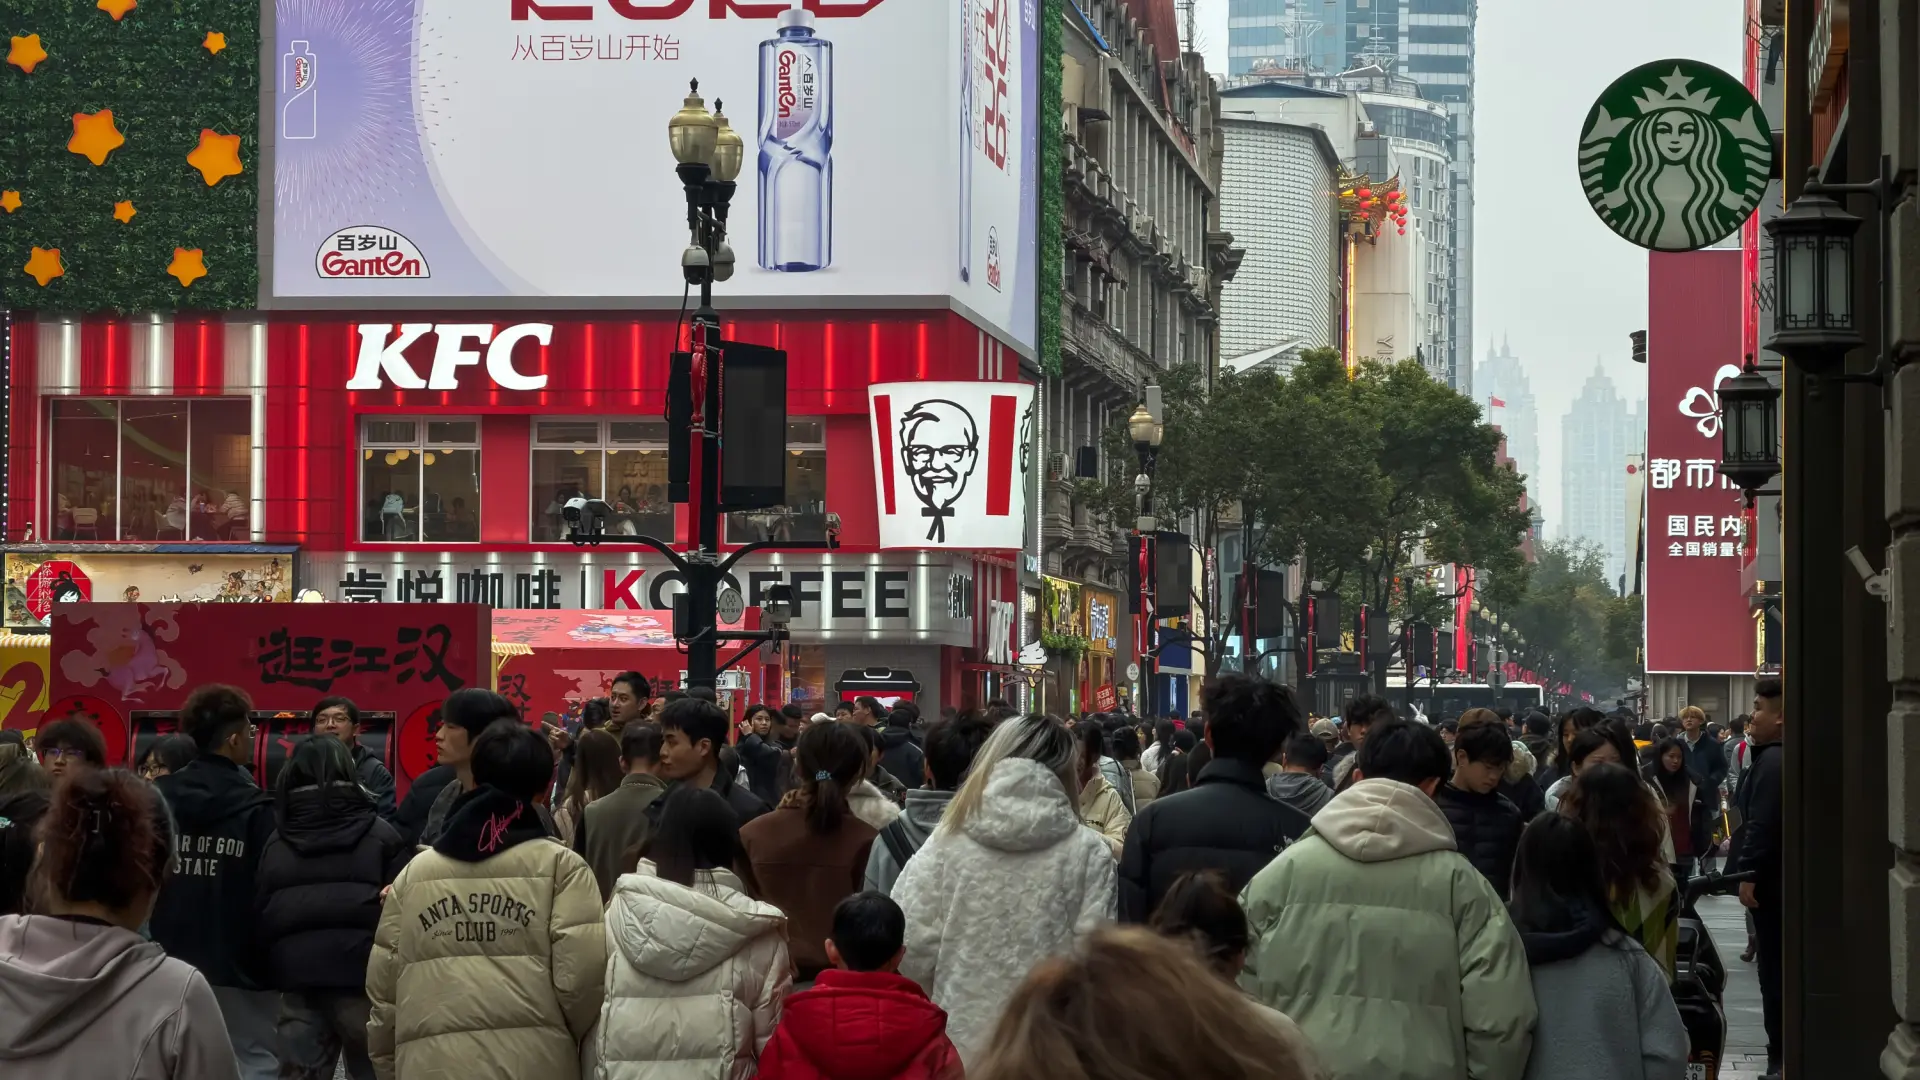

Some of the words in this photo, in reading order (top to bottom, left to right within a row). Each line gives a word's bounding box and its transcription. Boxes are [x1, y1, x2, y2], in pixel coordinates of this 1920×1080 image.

[511, 34, 680, 61] 从百岁山开始
[803, 73, 813, 108] 百岁山
[337, 235, 397, 250] 百岁山
[346, 323, 553, 390] KFC
[339, 568, 561, 609] 肯悦咖啡
[257, 623, 465, 692] 逛江汉
[197, 836, 212, 853] OF
[216, 837, 245, 857] GOD
[418, 894, 462, 932] ANTA
[468, 893, 536, 928] SPORTS
[455, 921, 496, 941] CLUB
